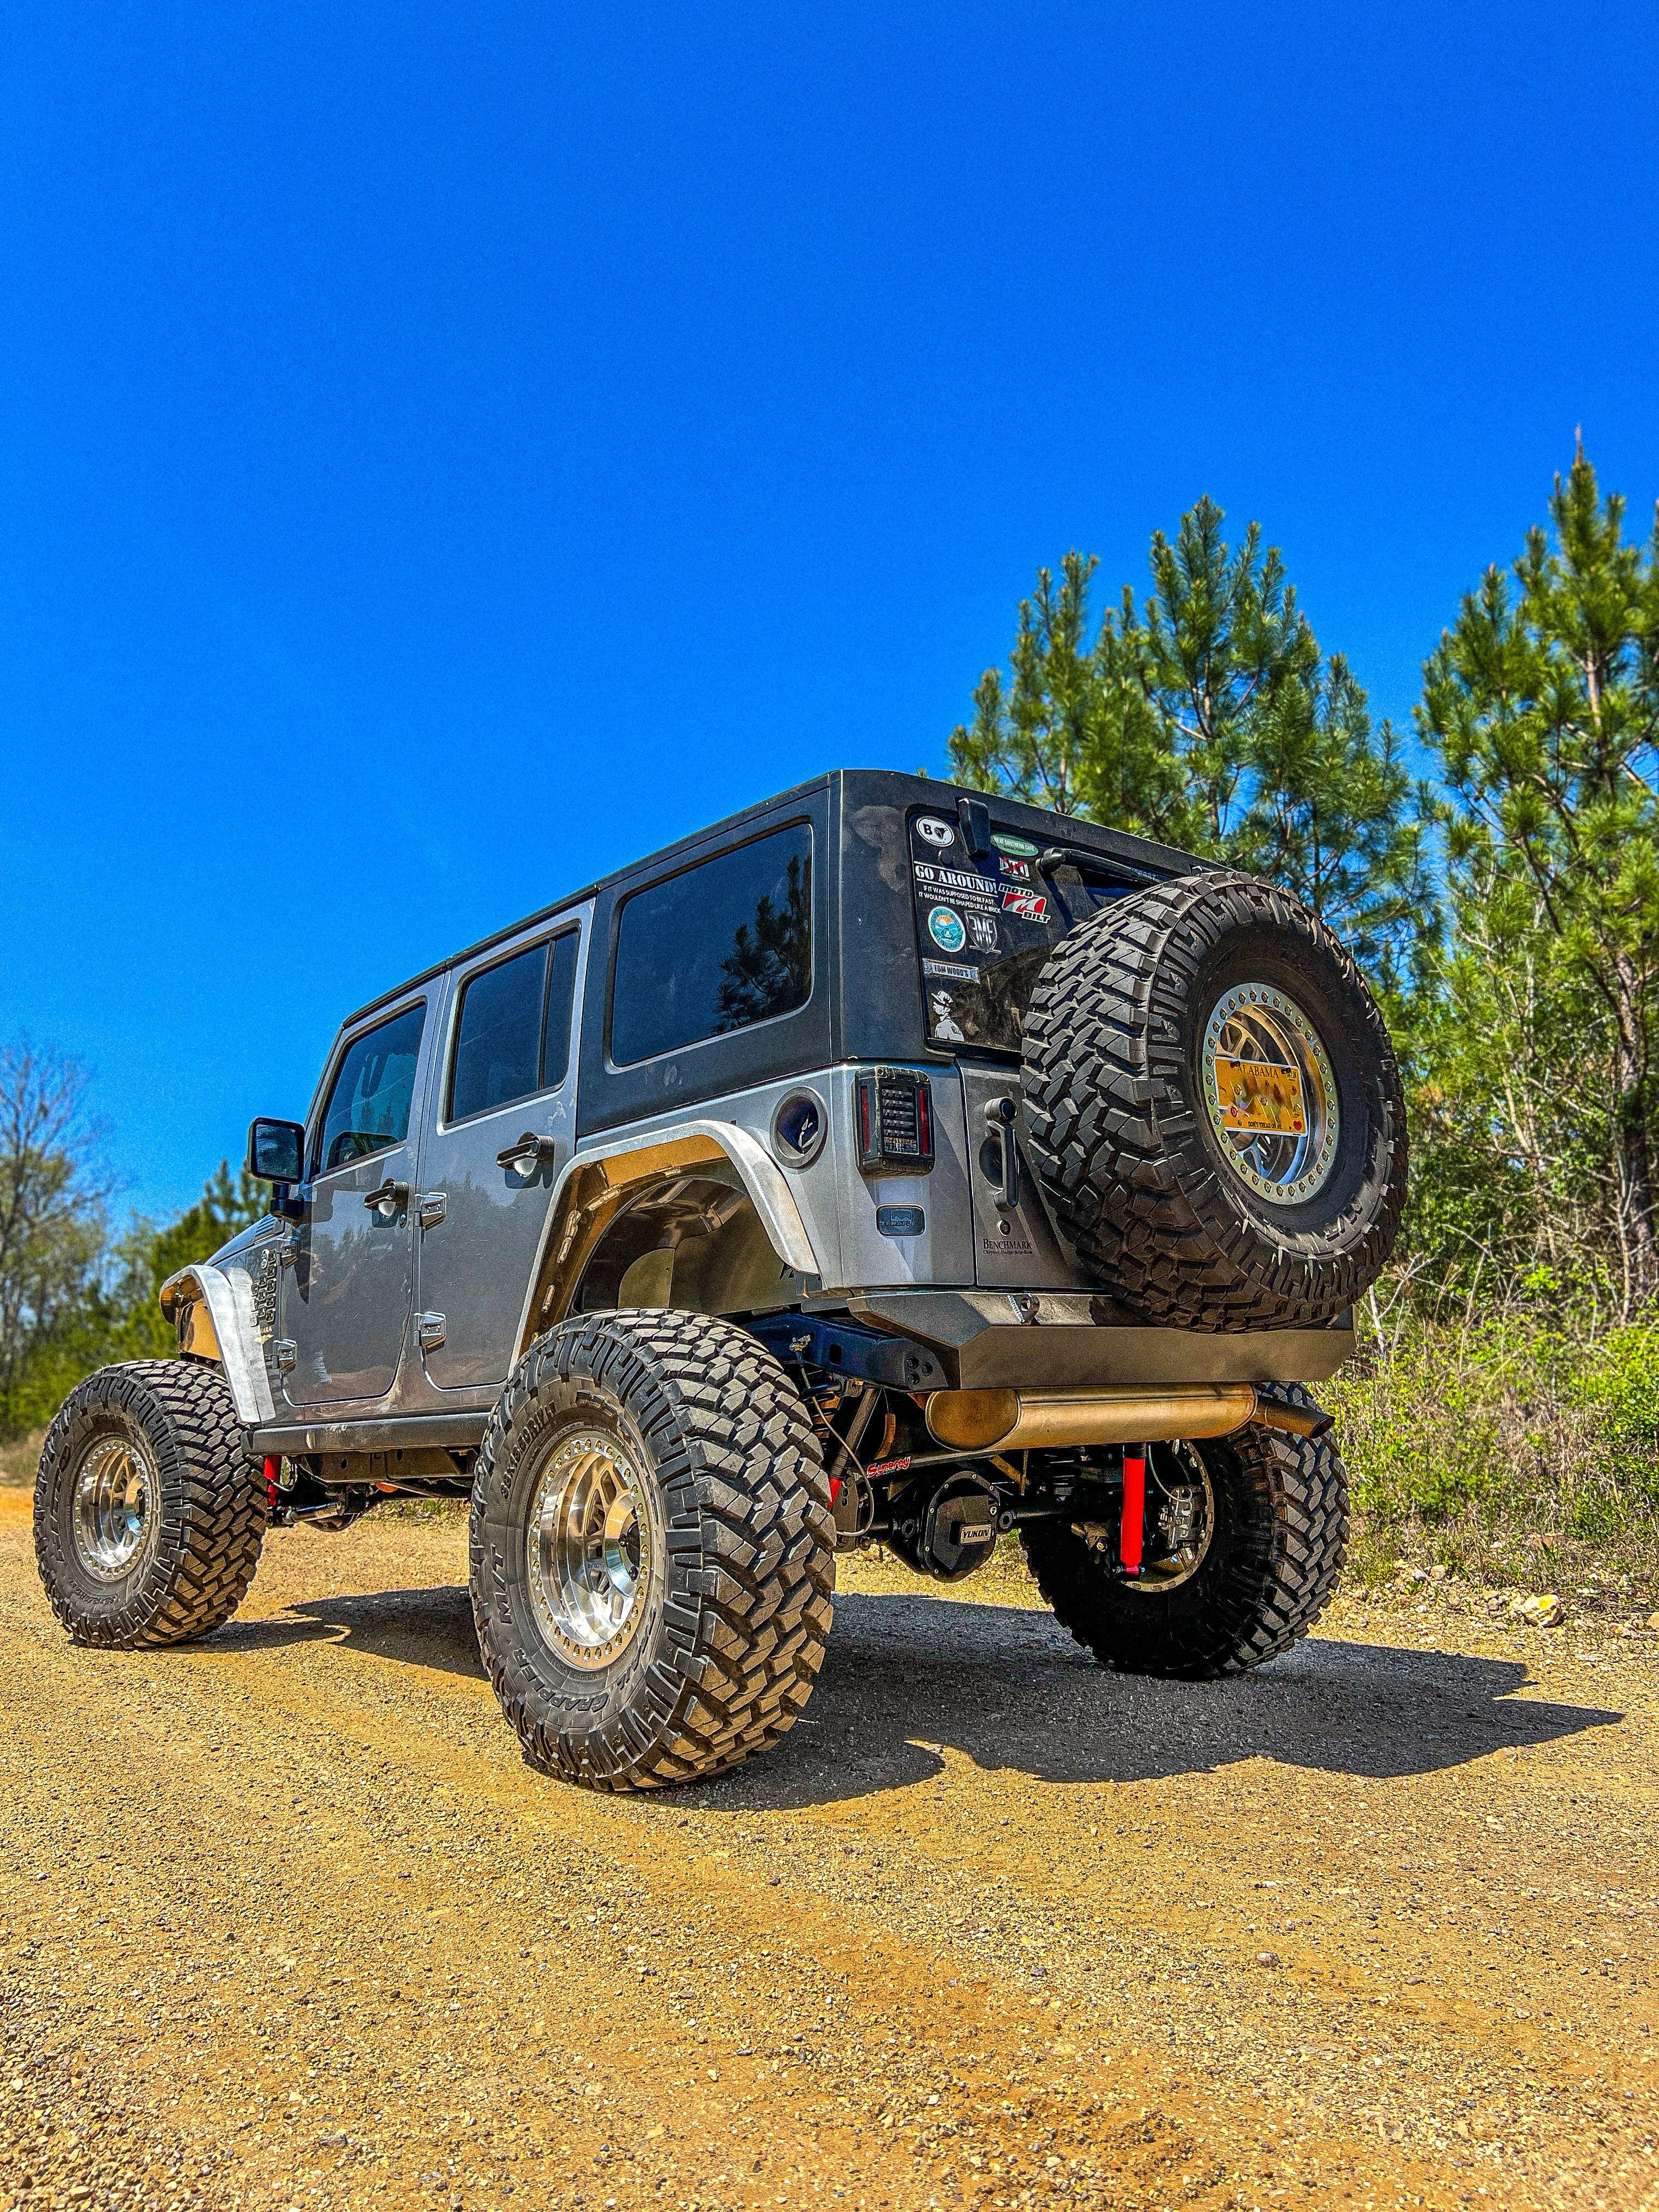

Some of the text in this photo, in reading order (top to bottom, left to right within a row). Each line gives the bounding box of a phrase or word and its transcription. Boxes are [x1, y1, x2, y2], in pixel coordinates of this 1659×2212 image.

[923, 823, 933, 835] B
[915, 865, 934, 880] GO
[938, 870, 997, 894] AROUND!
[945, 889, 969, 900] SUPPOSED
[998, 883, 1033, 898] MOTO
[924, 893, 949, 903] WOULDN'T
[956, 899, 974, 908] SHAPED
[1022, 911, 1051, 923] BILT
[933, 964, 969, 977] TOM WOOD'S
[1237, 1064, 1279, 1078] ALABAMA
[983, 1238, 1032, 1249] BENCHMARK
[866, 1455, 911, 1479] Synergy
[962, 1528, 989, 1539] YUKON
[491, 1543, 514, 1624] M/T
[512, 1647, 611, 1713] GRAPPLER
